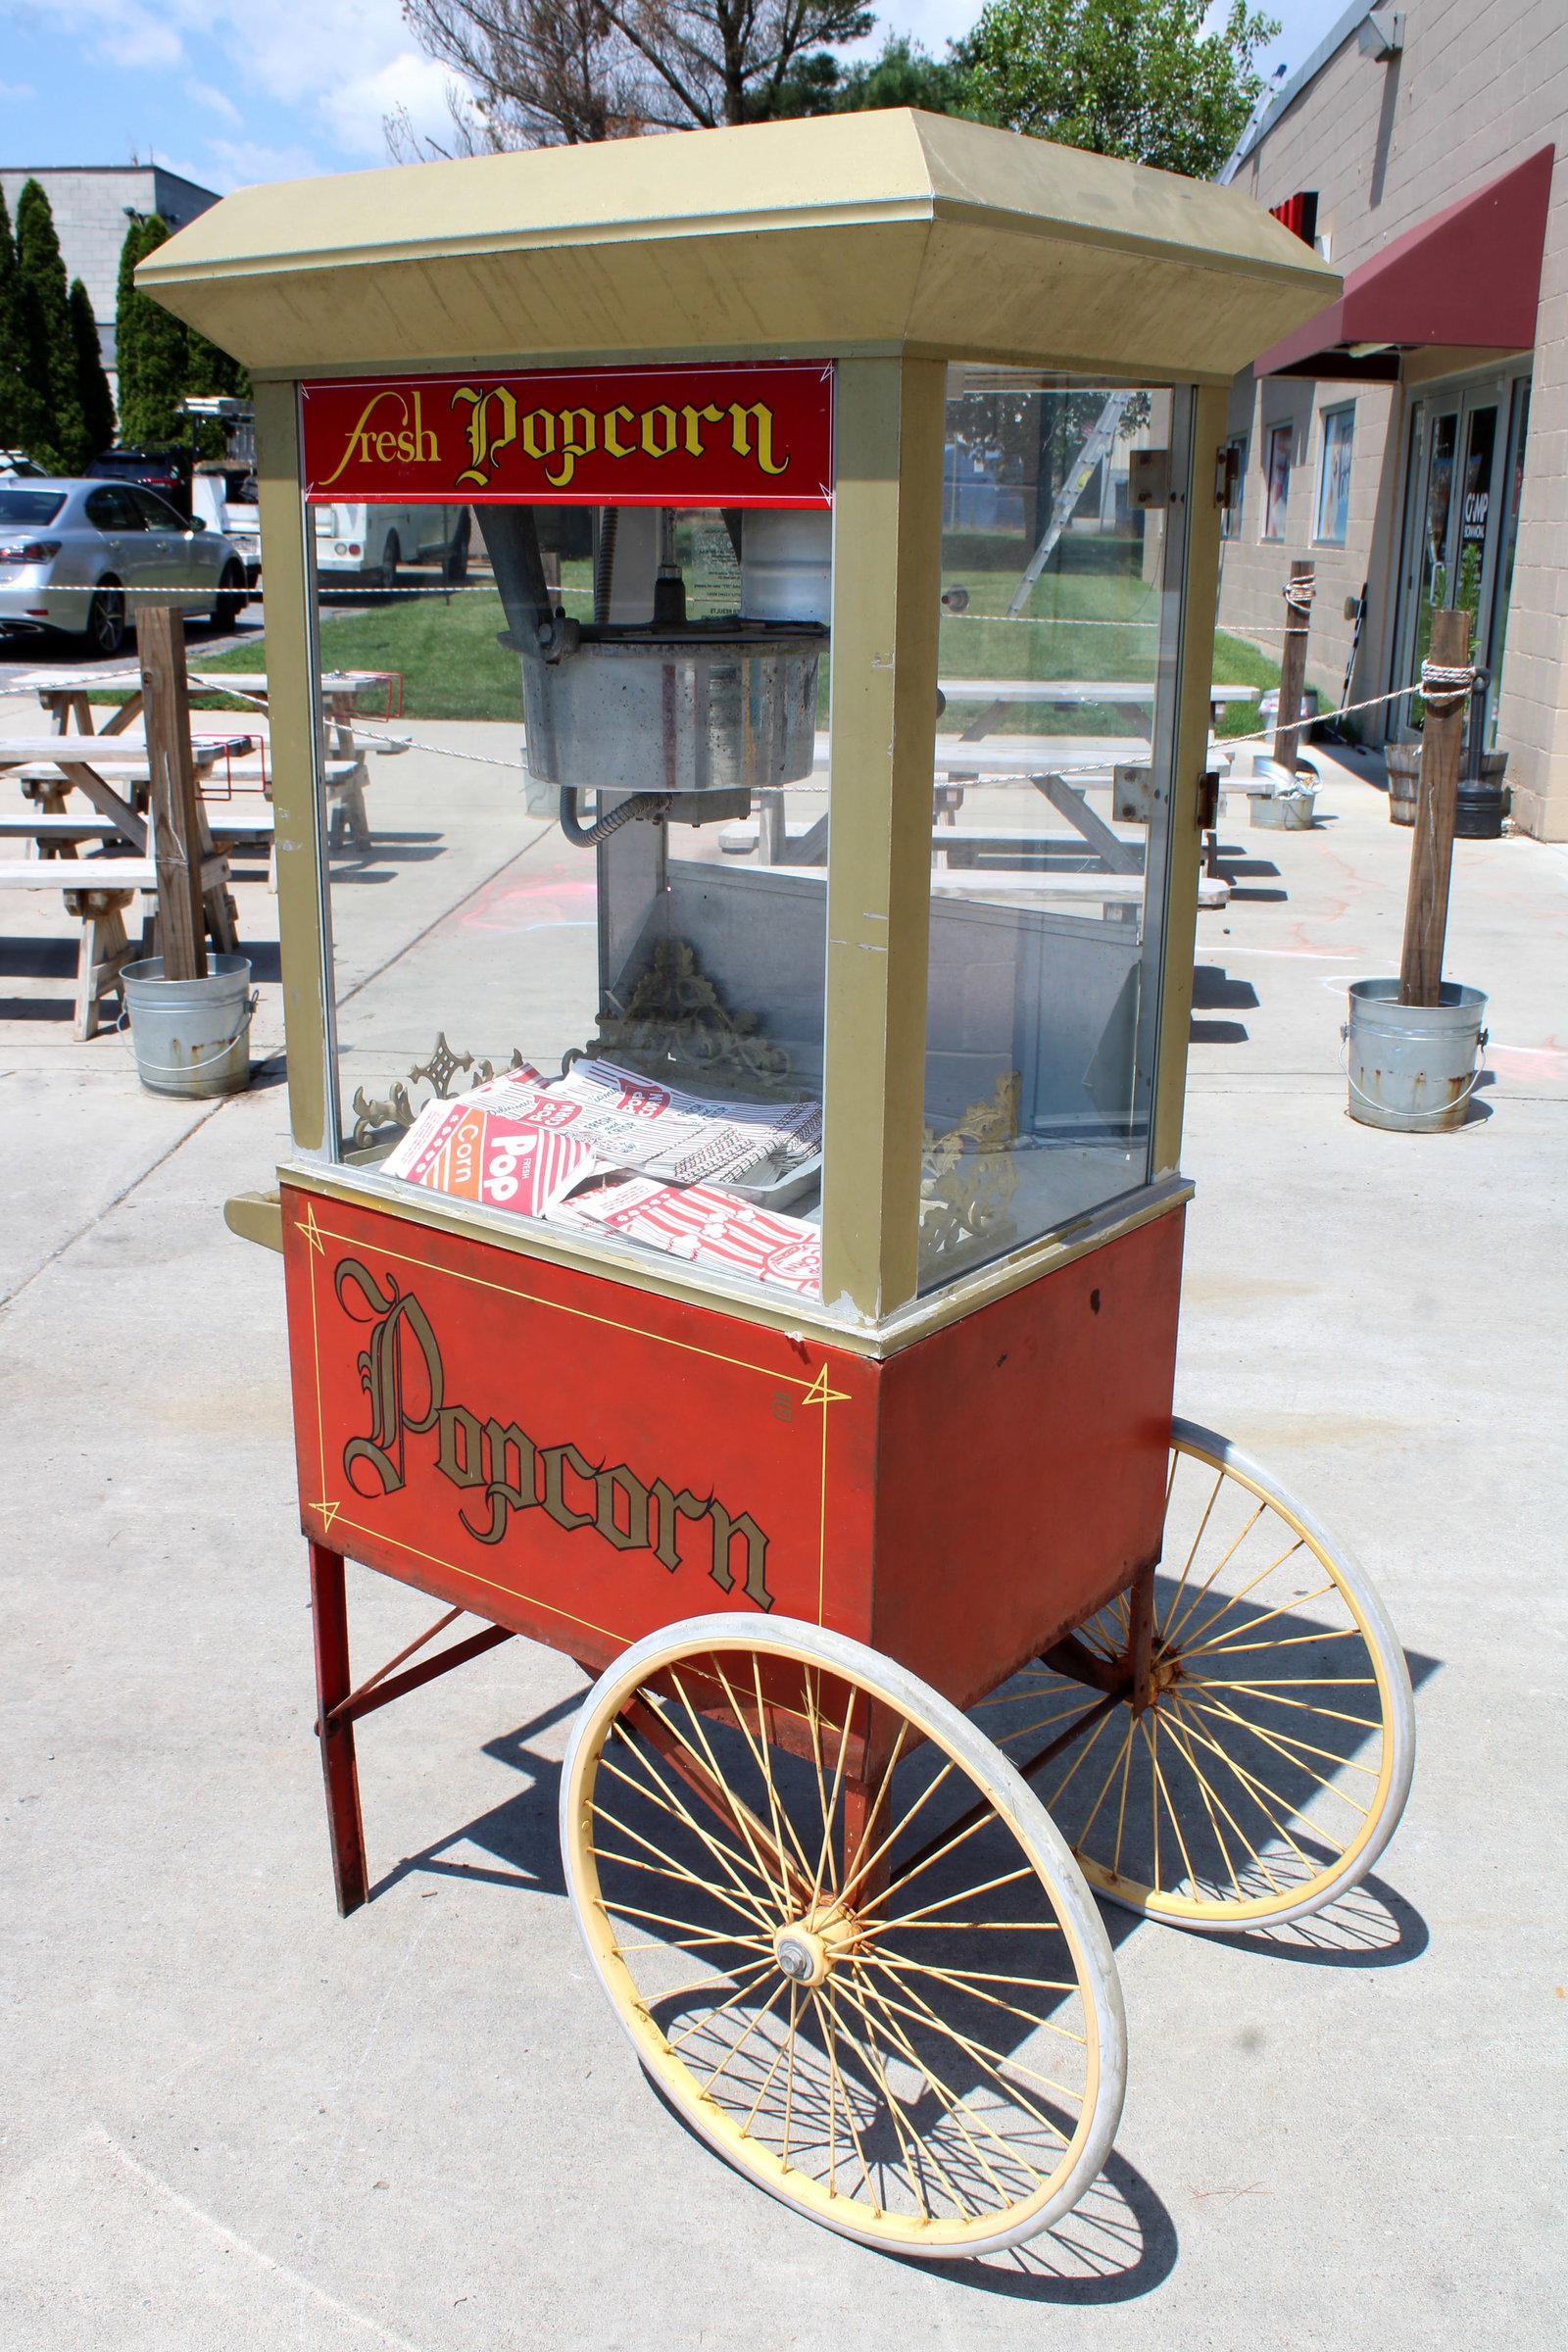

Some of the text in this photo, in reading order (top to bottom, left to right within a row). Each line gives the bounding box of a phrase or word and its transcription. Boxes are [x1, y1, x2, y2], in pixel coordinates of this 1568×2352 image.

[318, 385, 790, 487] fresh Popcorn
[527, 1102, 558, 1122] POP
[621, 1091, 646, 1114] POP
[638, 1093, 663, 1117] CORN
[544, 1104, 576, 1127] CORN
[455, 1124, 479, 1183] Corn
[484, 1134, 538, 1201] Pop
[522, 1157, 532, 1180] FRESH
[334, 1257, 775, 1612] Popcorn
